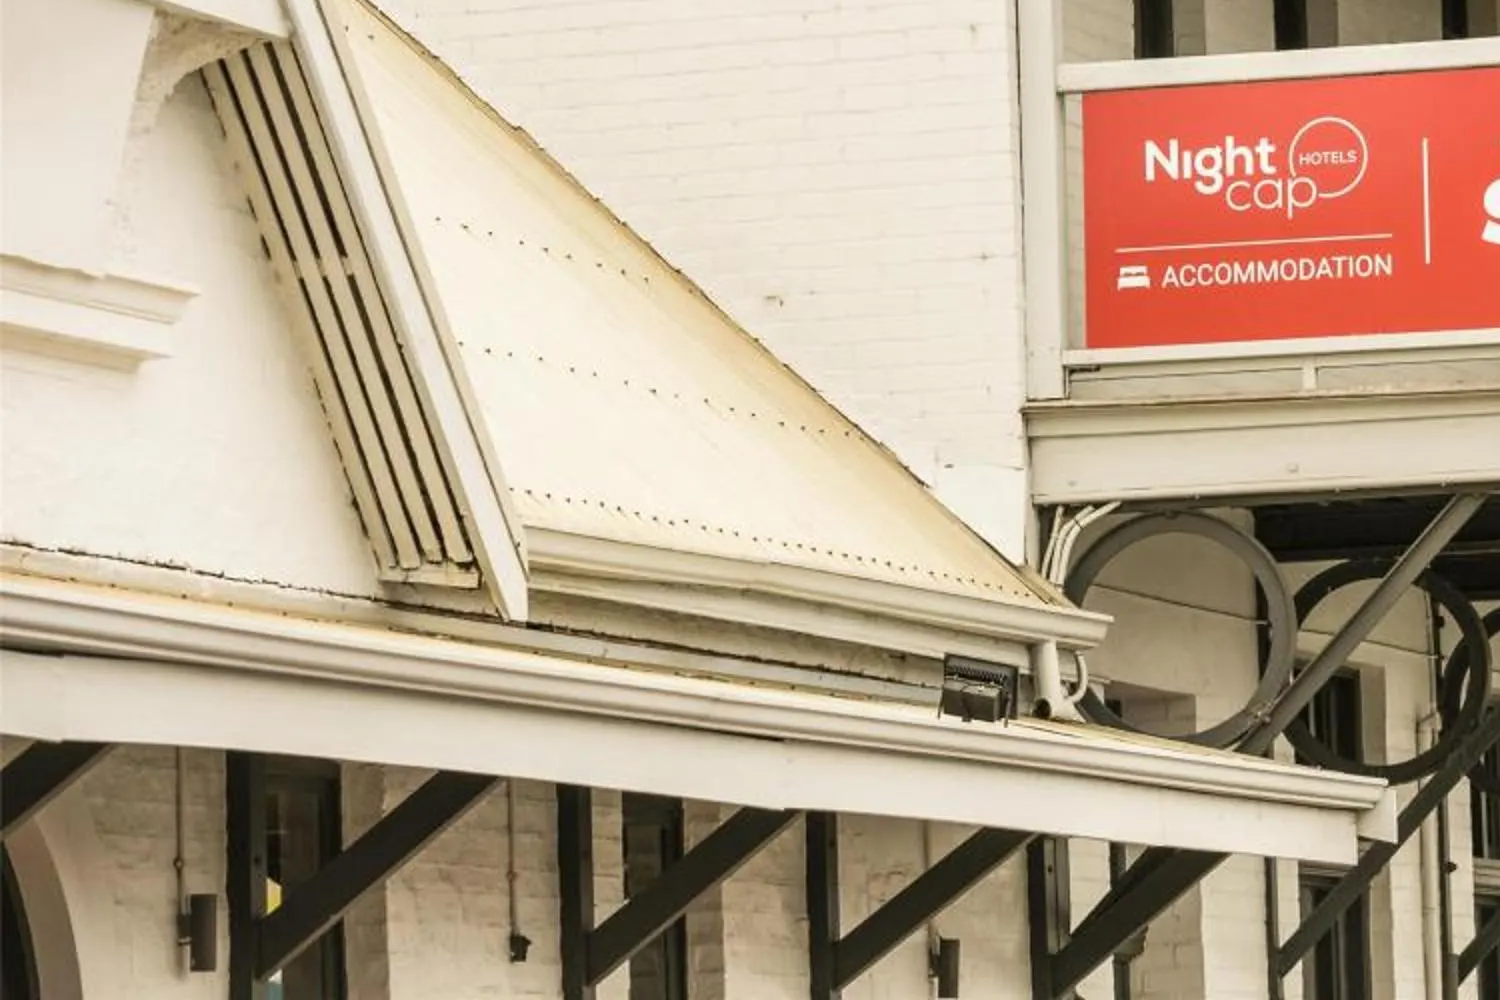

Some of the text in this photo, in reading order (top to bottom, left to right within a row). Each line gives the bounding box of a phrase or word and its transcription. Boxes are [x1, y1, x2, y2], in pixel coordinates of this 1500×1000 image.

[1145, 136, 1276, 194] Night
[1299, 148, 1358, 167] HOTELS
[1226, 175, 1317, 219] cap
[1161, 254, 1393, 289] ACCOMMODATION
